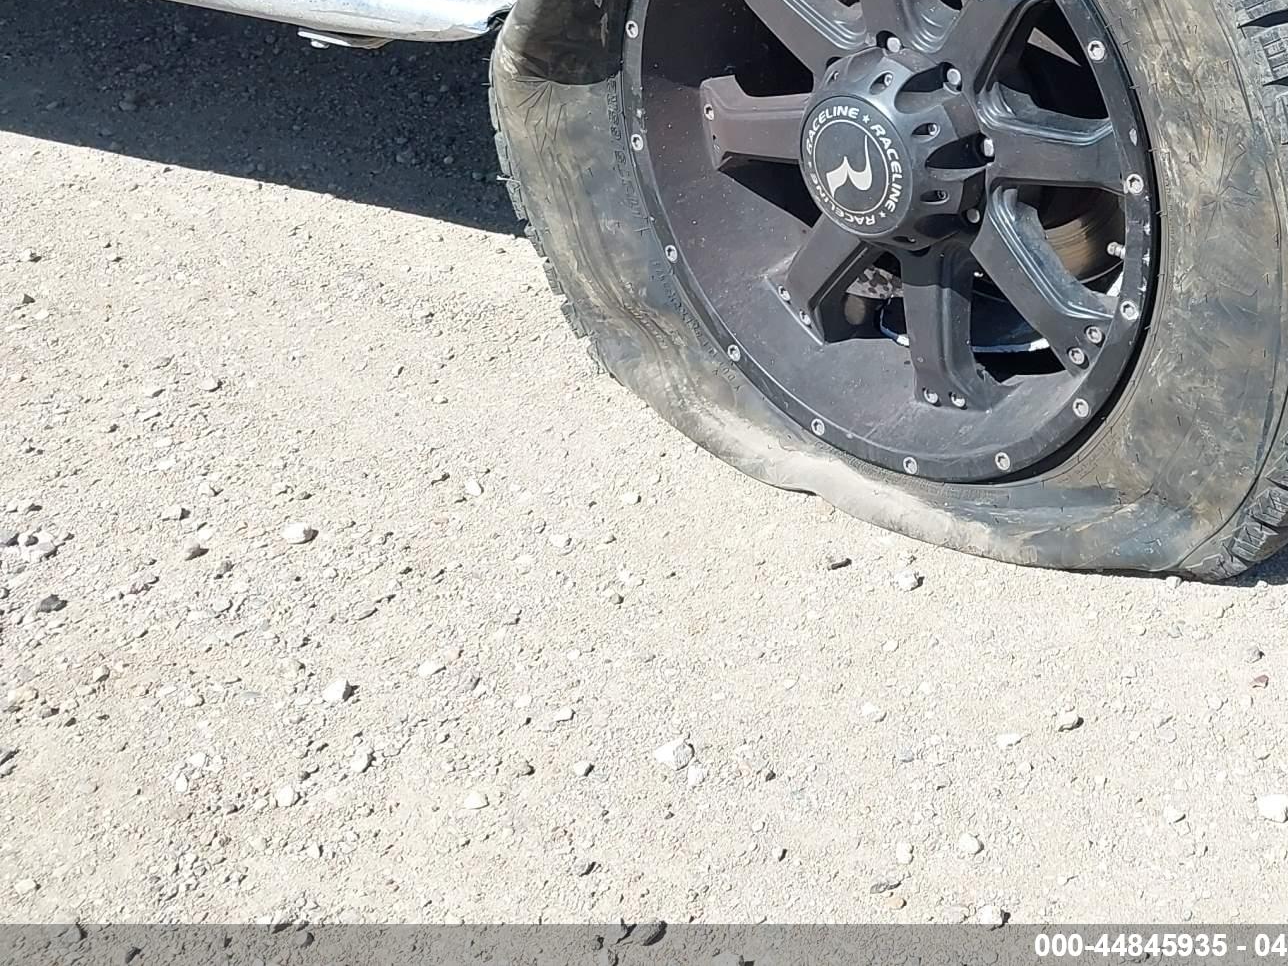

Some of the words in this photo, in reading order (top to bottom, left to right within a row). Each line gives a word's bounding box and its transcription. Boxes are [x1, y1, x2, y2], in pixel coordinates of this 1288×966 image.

[806, 105, 860, 156] RACELINE
[870, 124, 904, 213] RACELINE
[810, 172, 876, 226] RACELINE
